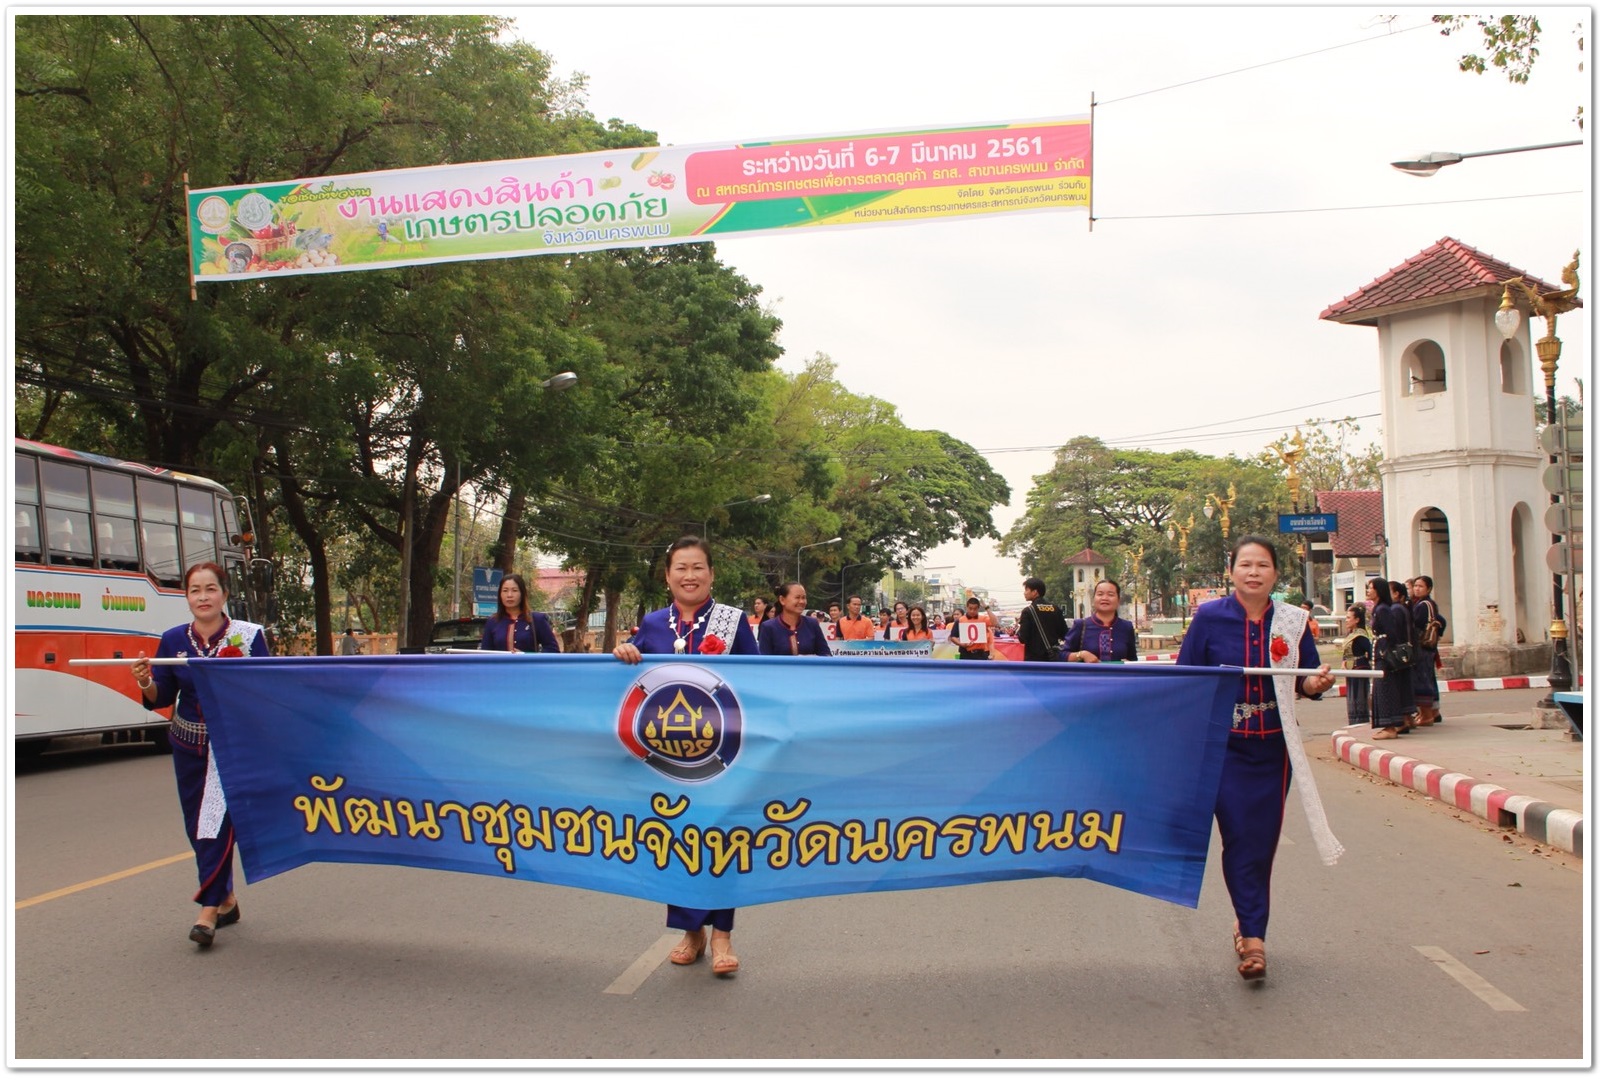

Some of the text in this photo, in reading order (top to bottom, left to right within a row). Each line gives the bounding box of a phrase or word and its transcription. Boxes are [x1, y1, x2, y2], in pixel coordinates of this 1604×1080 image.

[742, 136, 1043, 176] ระหว่างวันที่ 6-7 มีนาคม 2561
[696, 157, 1085, 198] ณ สหกรณ์การเกษตรเพื่อการตลาดลูกค้า ธกส. สาขานครพนม จำกัด
[989, 183, 1053, 196] จังหวัดนครพนม
[338, 171, 594, 218] งานแสดงสินค้า
[404, 192, 668, 239] เกษตรปลอดภัย
[543, 222, 670, 245] จังหวัดนครพนม
[26, 590, 82, 609] นครพนม
[827, 624, 837, 641] 3
[967, 624, 978, 641] 0
[293, 774, 1124, 877] พัฒนาชุมชนจังหวัดนครพนม
